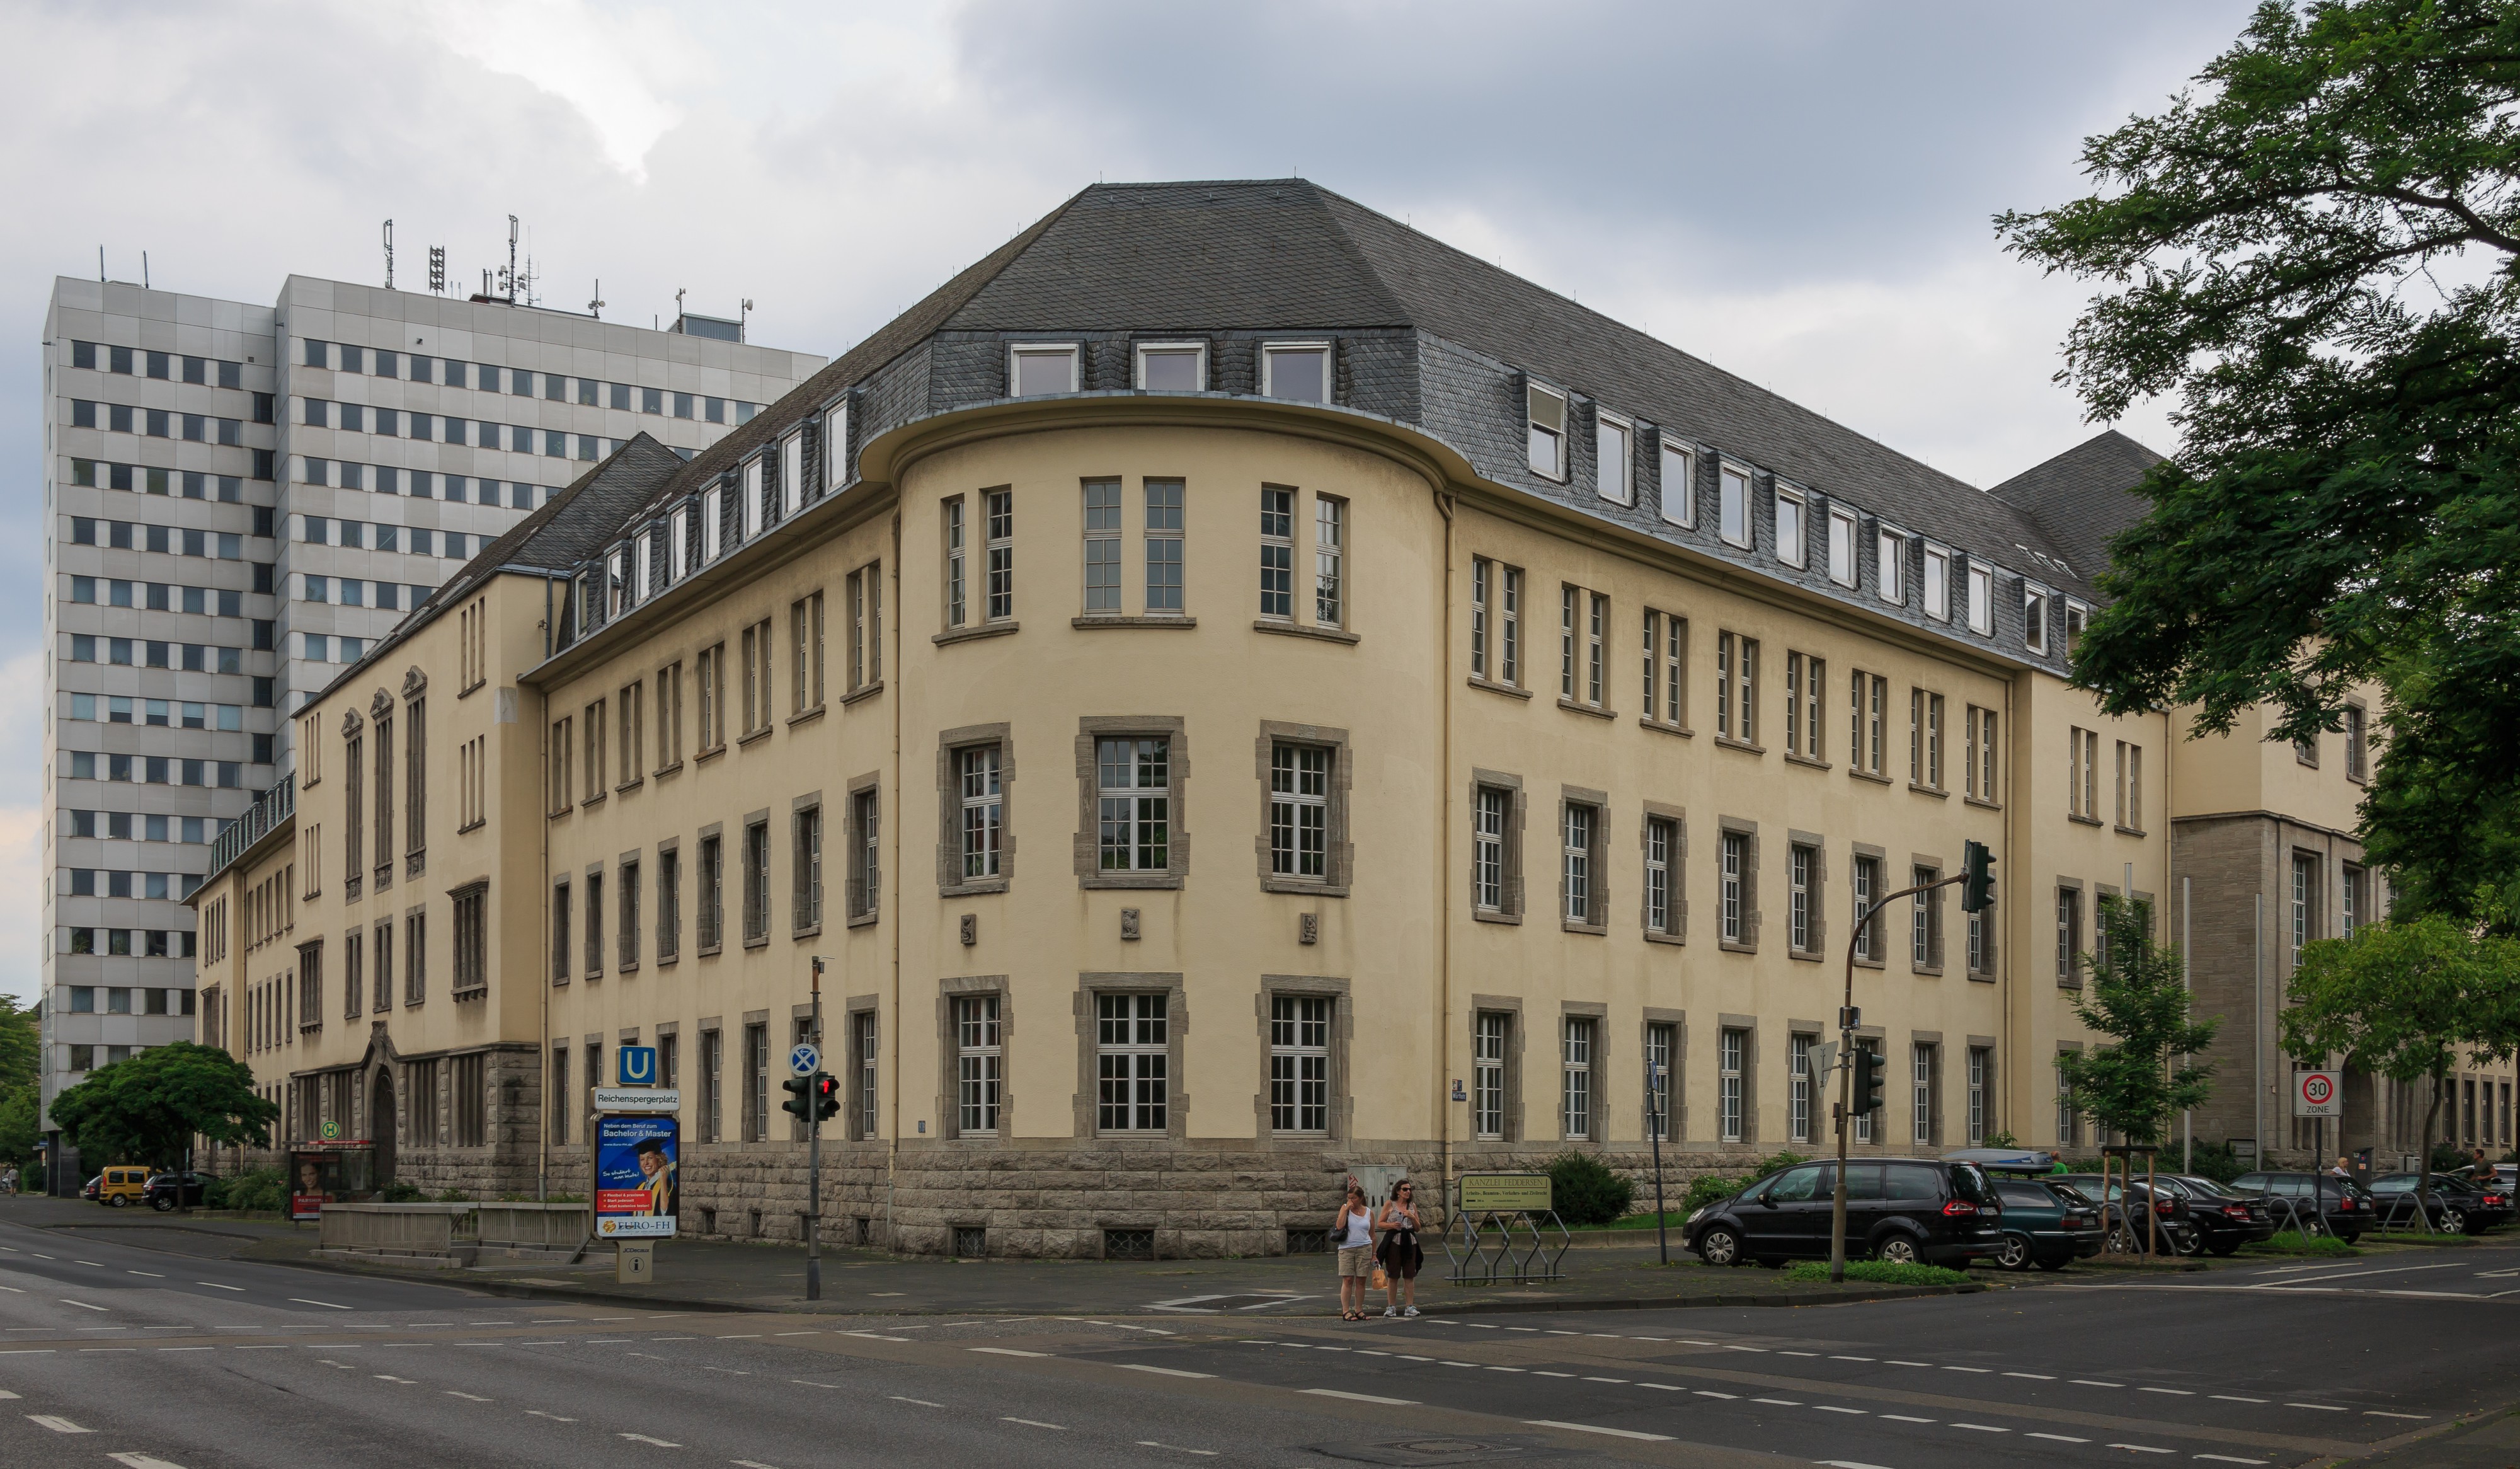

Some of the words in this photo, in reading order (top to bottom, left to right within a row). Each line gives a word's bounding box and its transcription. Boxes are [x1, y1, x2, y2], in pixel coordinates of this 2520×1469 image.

[627, 1051, 649, 1079] U
[2309, 1083, 2327, 1096] 30
[598, 1095, 677, 1104] Reichenspergerplatz
[2306, 1105, 2330, 1114] ZONE
[326, 1125, 335, 1134] H
[618, 1221, 670, 1230] EURO-FH
